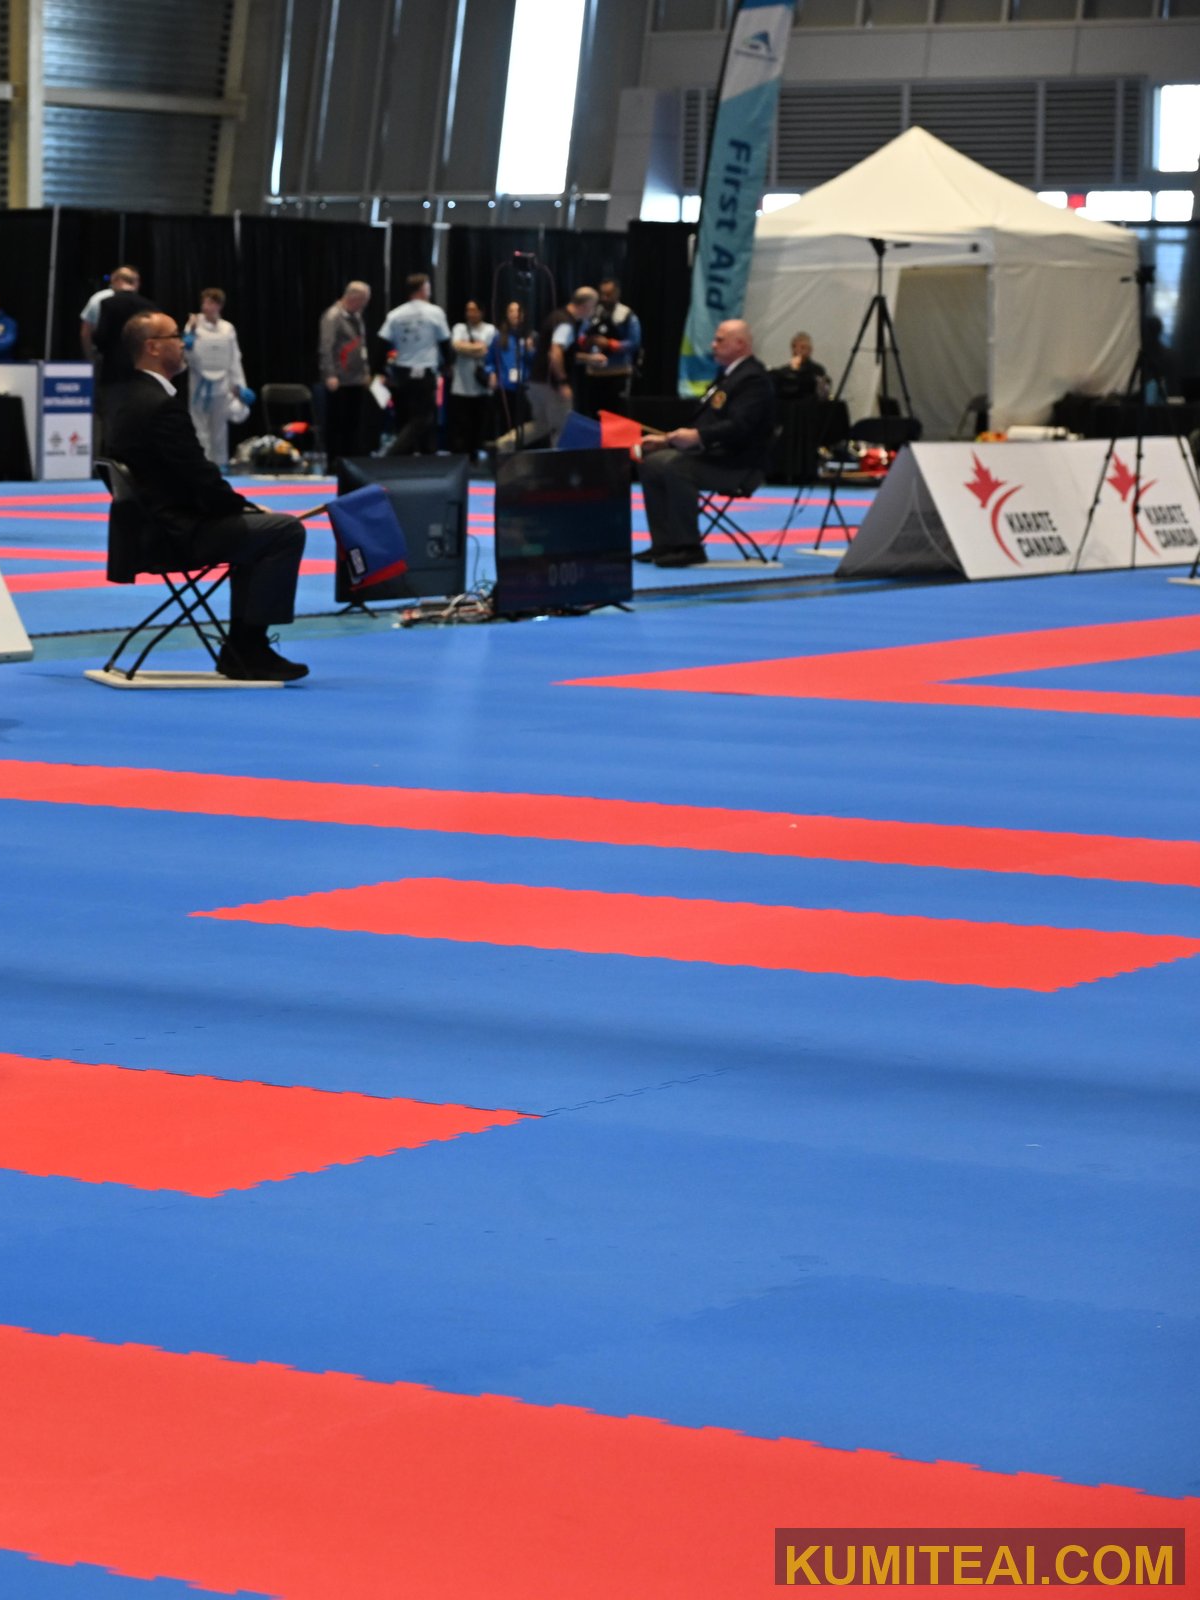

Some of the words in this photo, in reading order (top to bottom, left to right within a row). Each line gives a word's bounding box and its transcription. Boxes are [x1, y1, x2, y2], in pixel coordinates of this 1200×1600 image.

[715, 138, 751, 231] First
[704, 244, 736, 312] Aid
[1004, 511, 1058, 533] KARATE
[1143, 504, 1189, 525] KARATE
[1016, 535, 1070, 559] CANADA
[1154, 528, 1199, 549] CANADA
